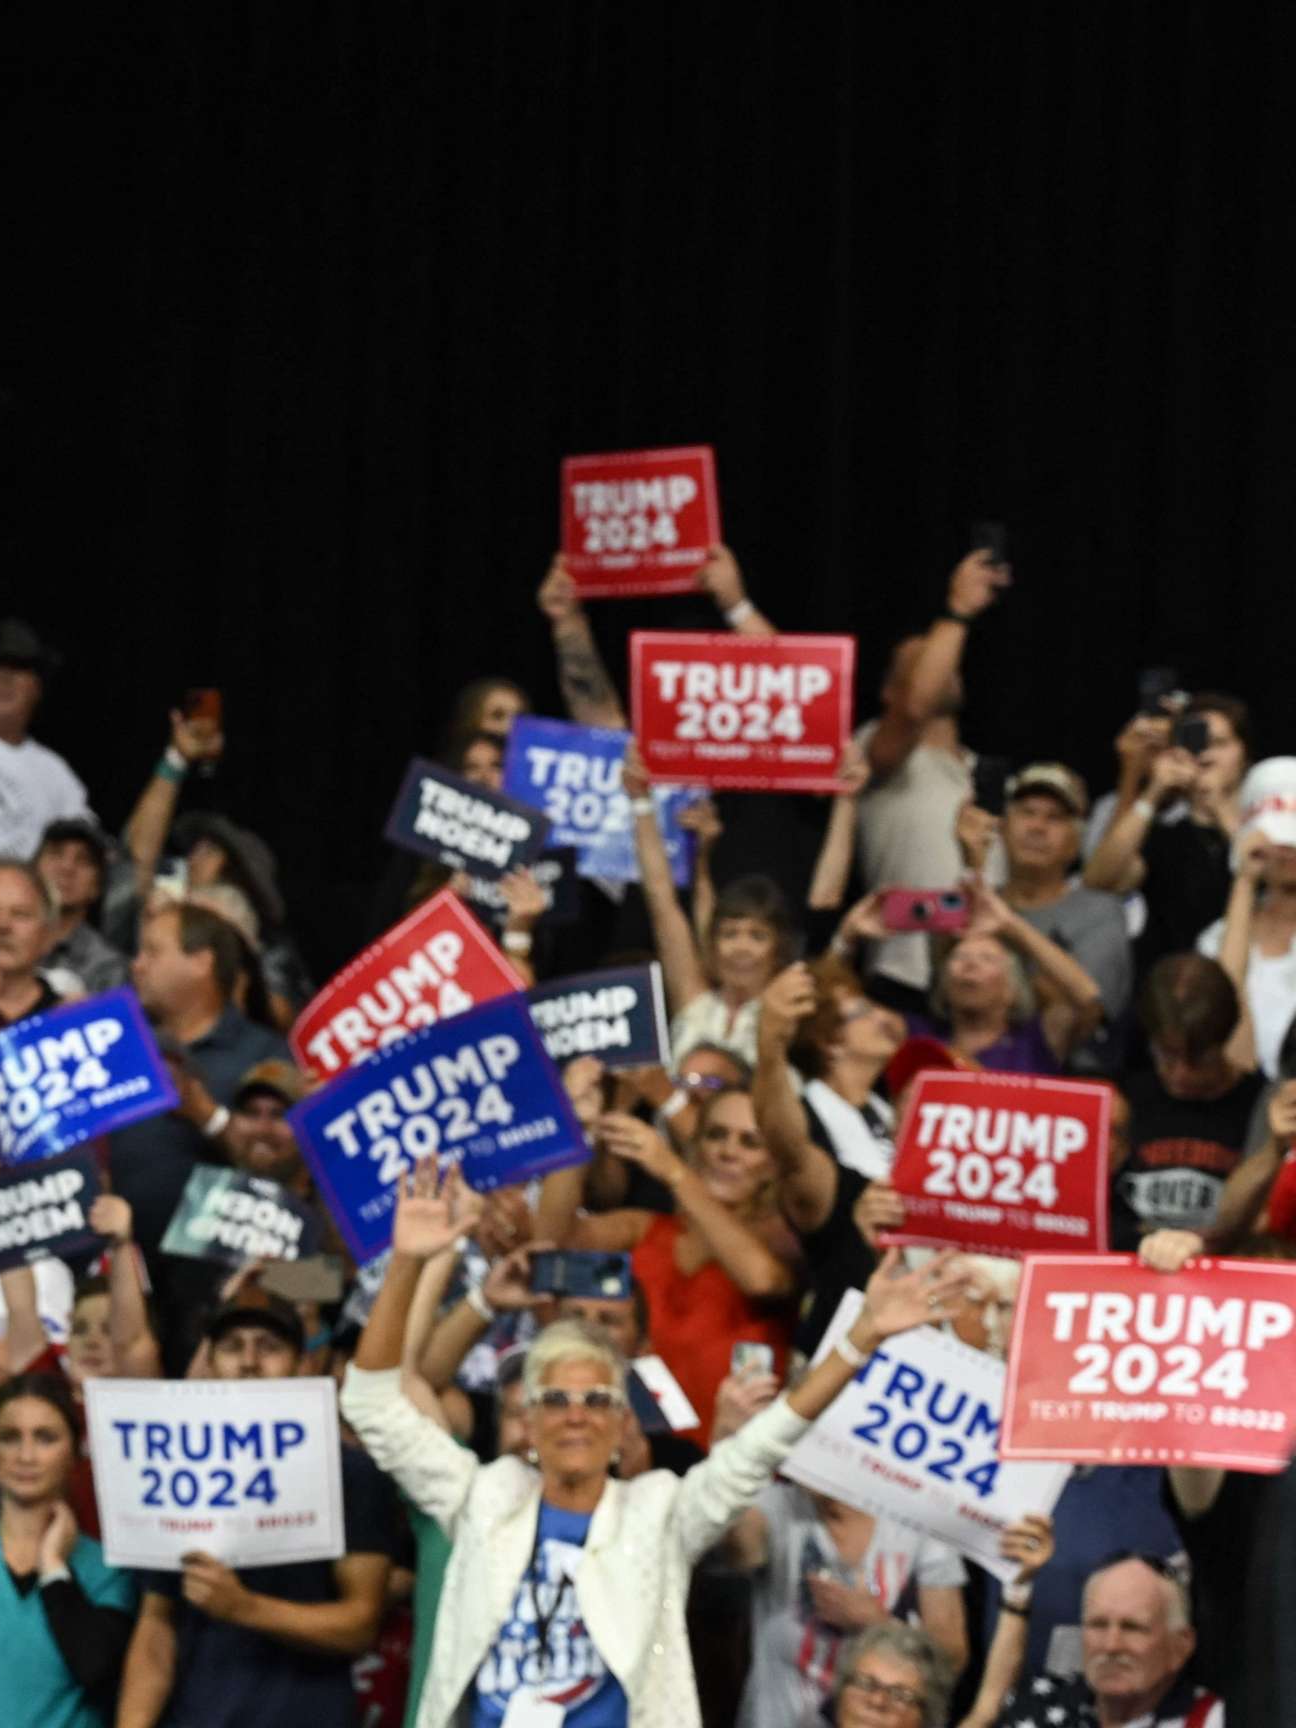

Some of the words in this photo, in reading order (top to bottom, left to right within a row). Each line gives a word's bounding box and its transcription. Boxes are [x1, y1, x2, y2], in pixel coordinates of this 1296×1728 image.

[572, 474, 698, 519] TRUMP
[583, 511, 679, 553] 2024
[651, 660, 832, 706] TRUMP
[675, 701, 806, 741] 2024
[526, 745, 625, 792] TRU
[419, 777, 532, 843] TRUMP
[544, 786, 633, 832] 202
[413, 808, 514, 869] NOEM
[308, 930, 464, 1070] TRUMP
[349, 979, 474, 1068] 24
[323, 1034, 521, 1159] TRUMP
[368, 1083, 515, 1185] 2024
[916, 1102, 1089, 1164] TRUMP
[923, 1149, 1060, 1209] 2024
[1044, 1291, 1295, 1350] TRUMP
[1067, 1343, 1250, 1400] 2024
[112, 1419, 307, 1462] TRUMP
[1088, 1402, 1169, 1423] TRUMP
[850, 1402, 1002, 1498] 2024
[140, 1467, 277, 1508] 2024
